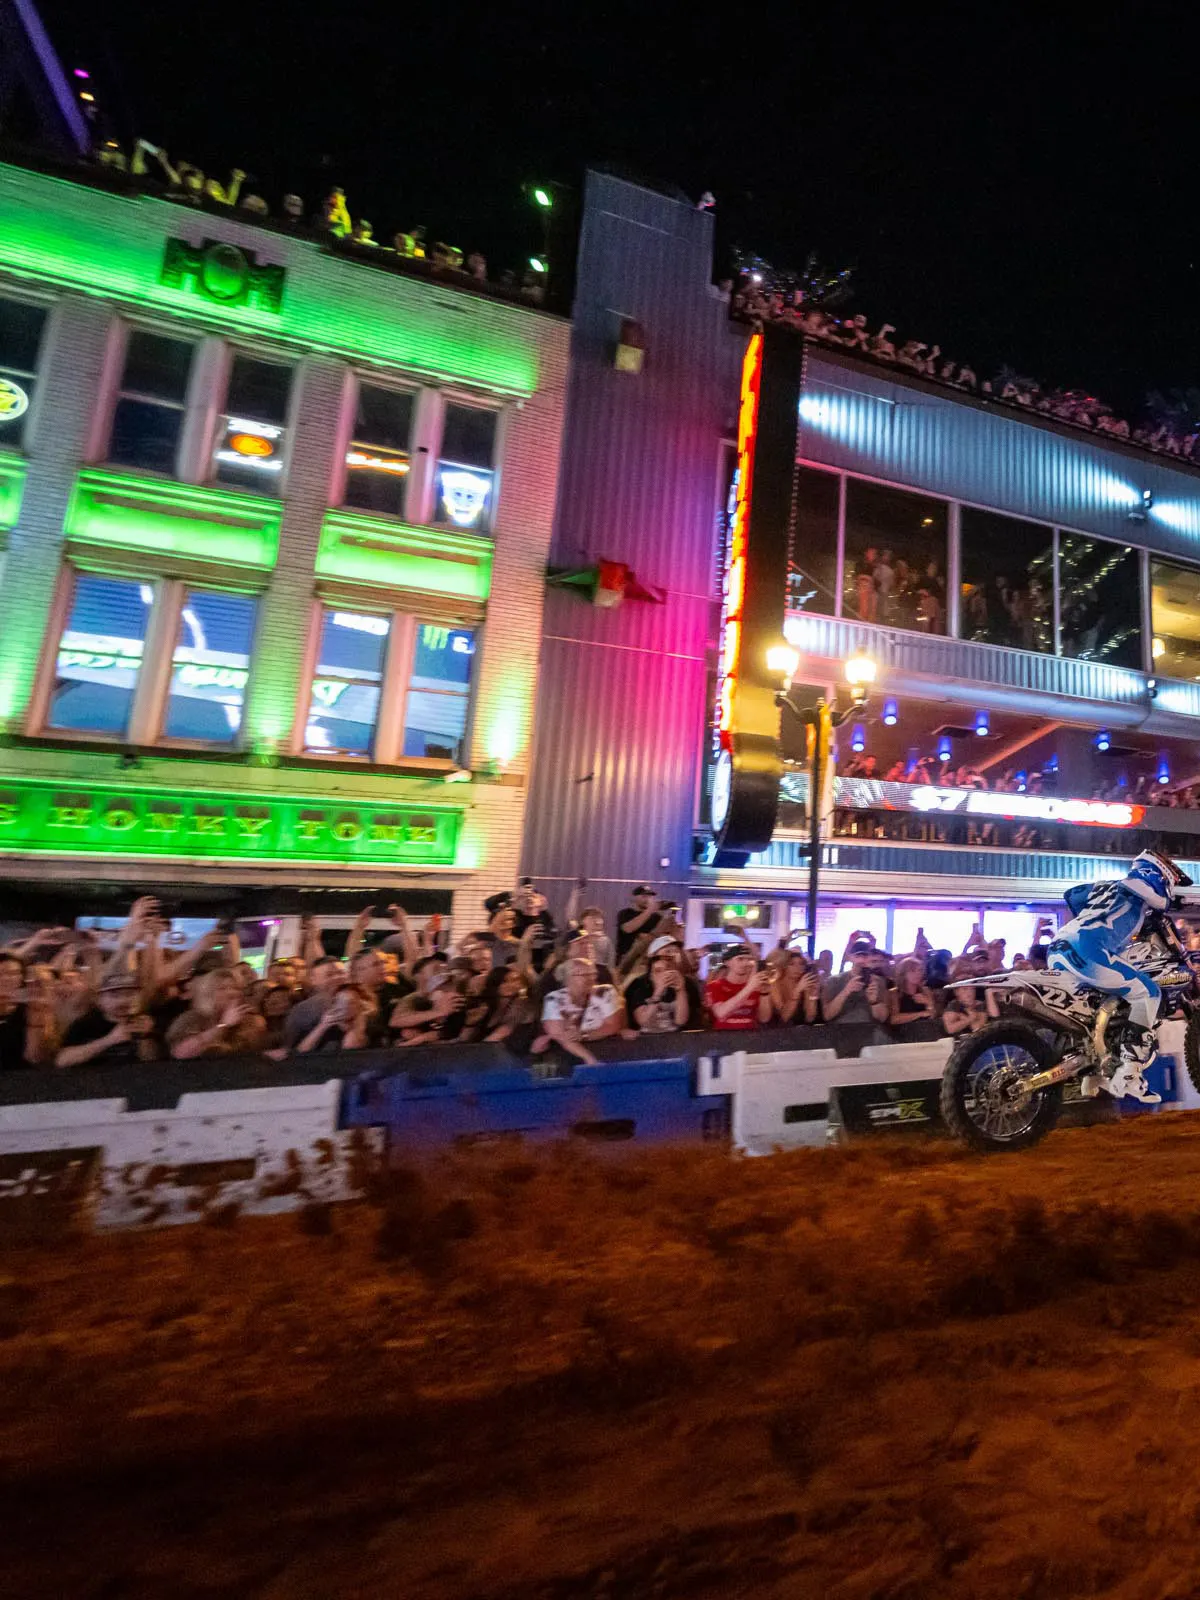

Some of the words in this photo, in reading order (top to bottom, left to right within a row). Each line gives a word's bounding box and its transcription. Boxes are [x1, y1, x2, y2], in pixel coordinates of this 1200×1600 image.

[46, 792, 273, 838] HONKY
[294, 808, 438, 845] TONK
[1042, 985, 1067, 1008] 22
